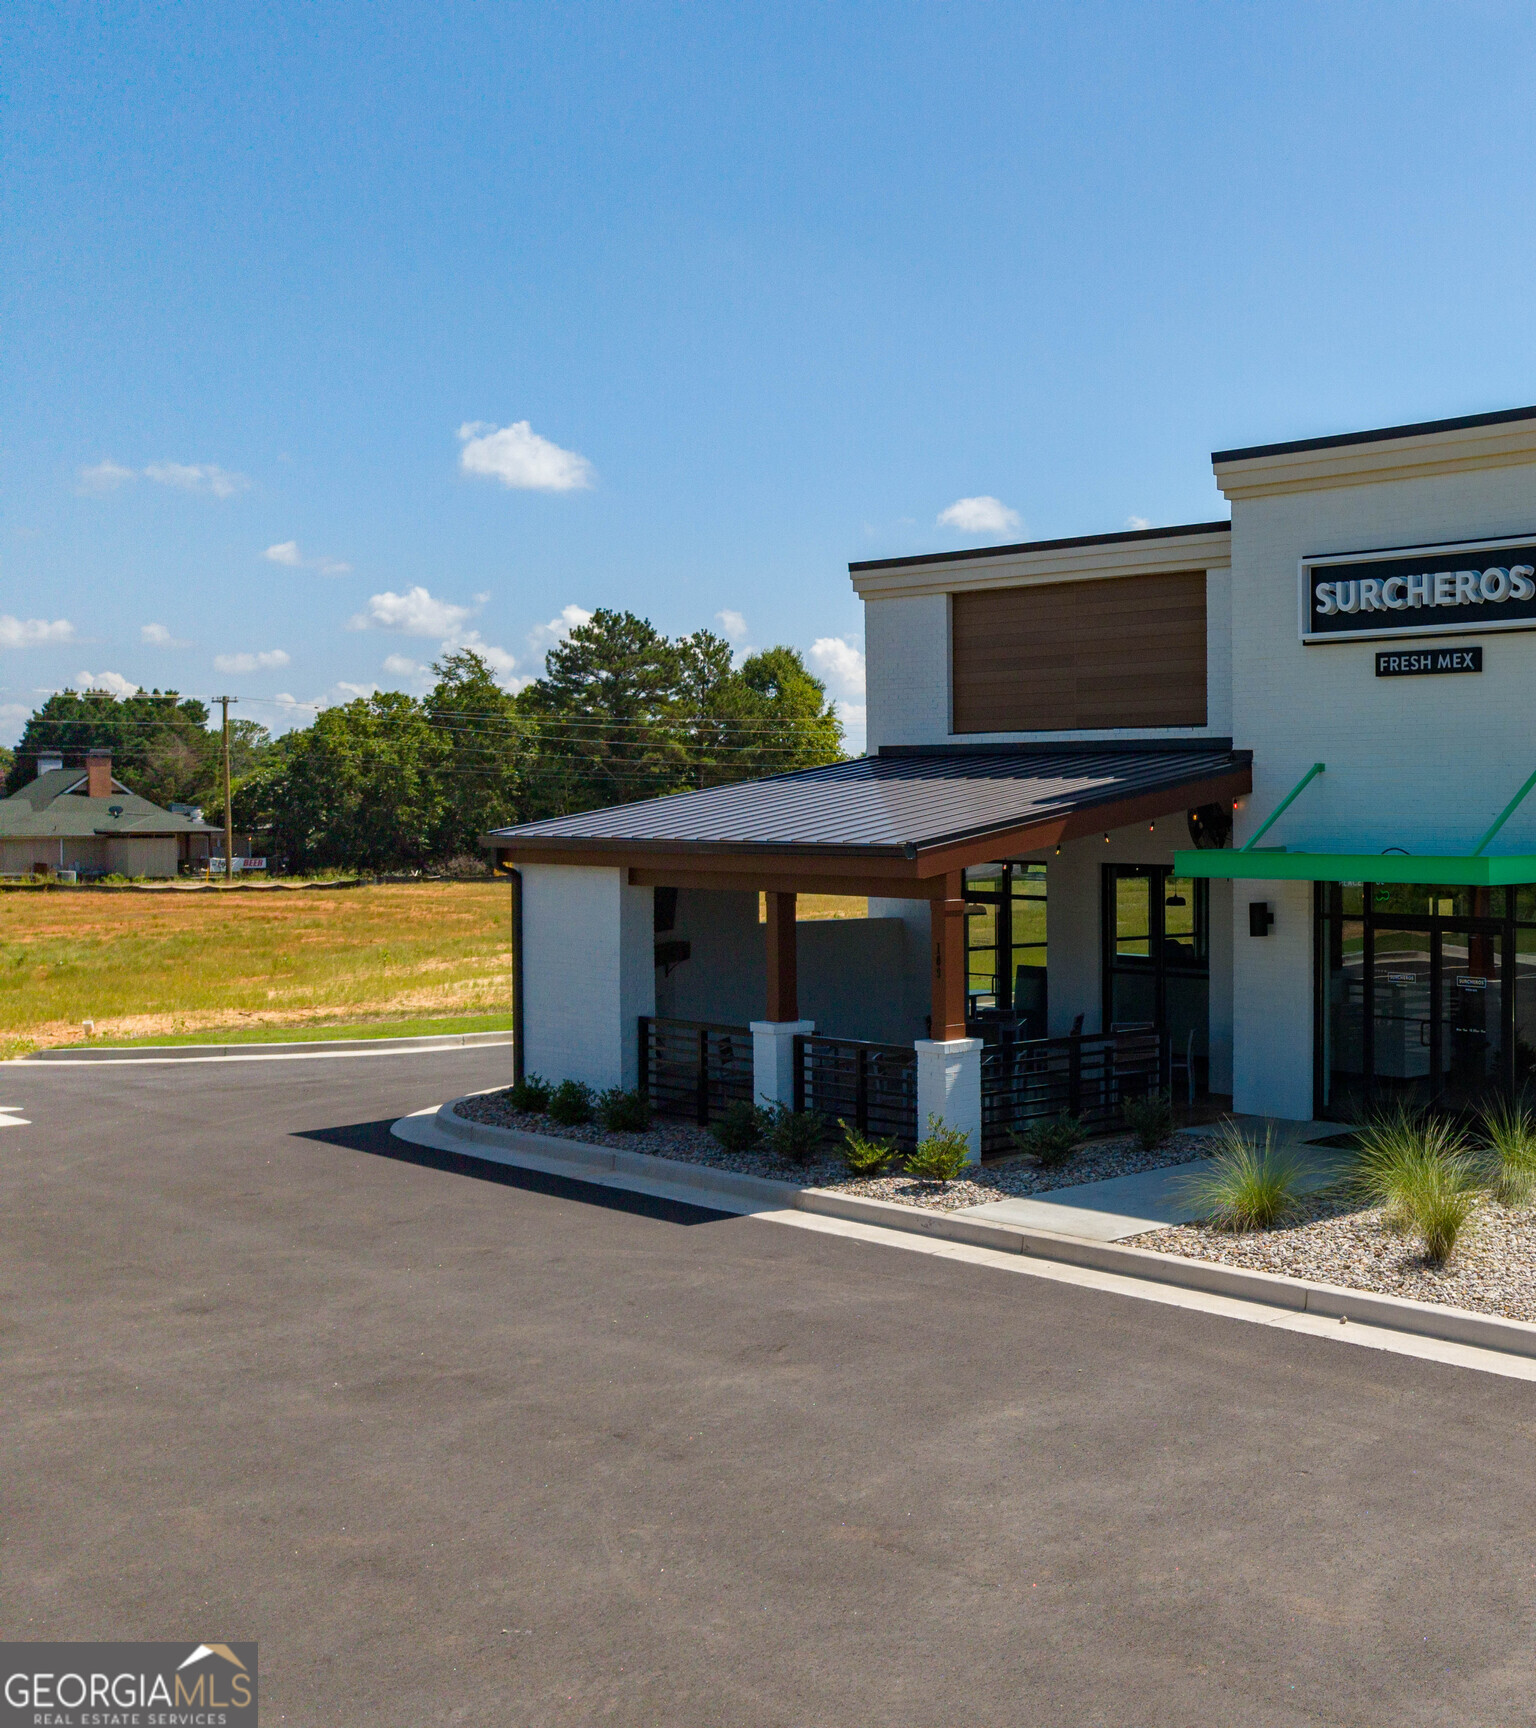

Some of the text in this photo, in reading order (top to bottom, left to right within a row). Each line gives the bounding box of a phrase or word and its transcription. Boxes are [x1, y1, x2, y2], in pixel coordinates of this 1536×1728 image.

[1315, 564, 1535, 615] SURCHEROS
[1379, 652, 1475, 672] FRESH MEX
[243, 859, 263, 867] BEER
